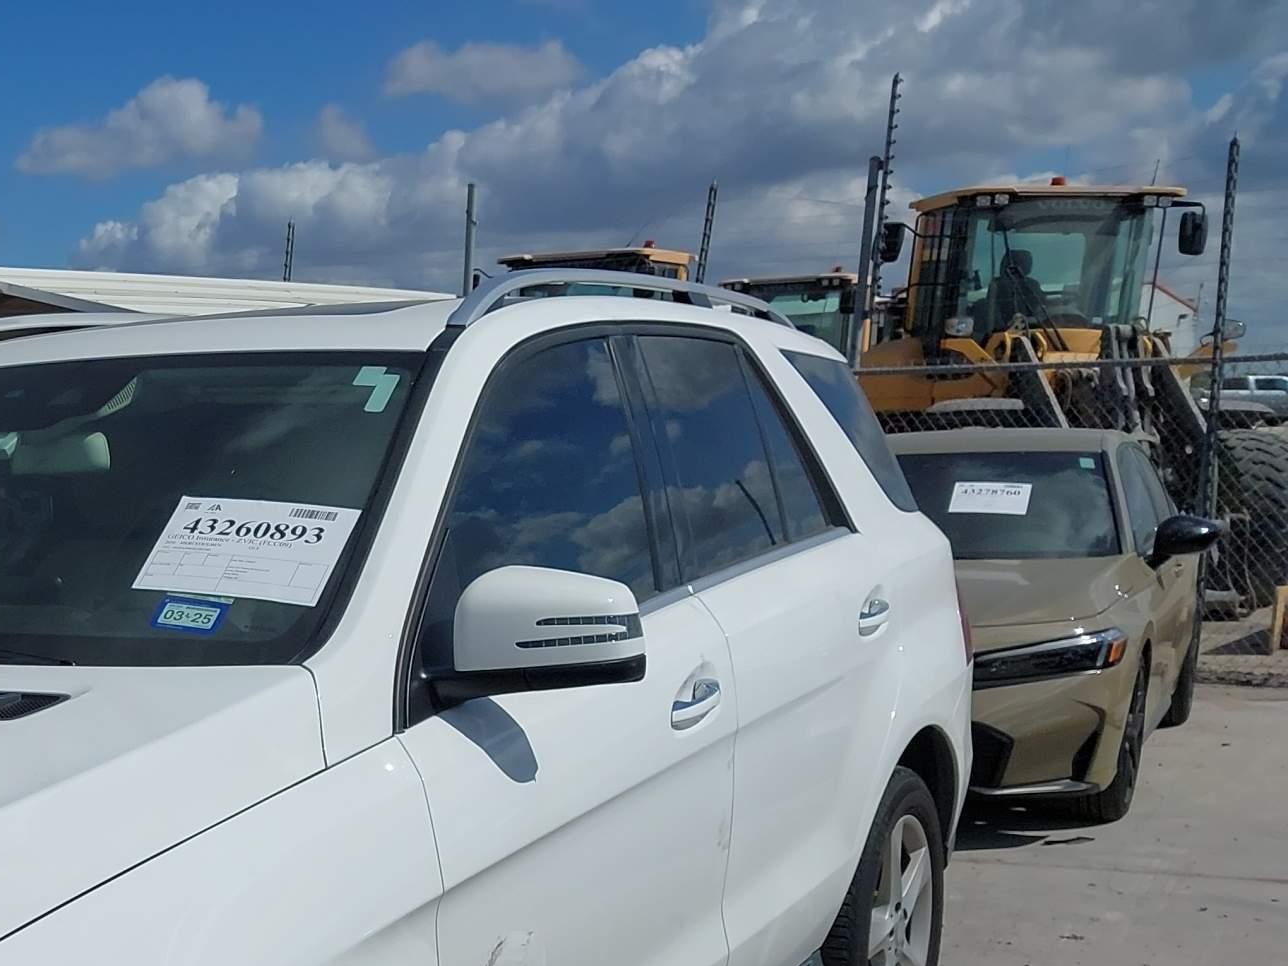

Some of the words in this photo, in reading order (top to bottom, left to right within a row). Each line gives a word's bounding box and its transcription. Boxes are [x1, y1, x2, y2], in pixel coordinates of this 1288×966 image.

[167, 533, 195, 541] GEICO
[196, 534, 230, 543] Insurance
[183, 516, 325, 545] 43260893
[163, 609, 185, 621] 03
[190, 612, 214, 625] 25
